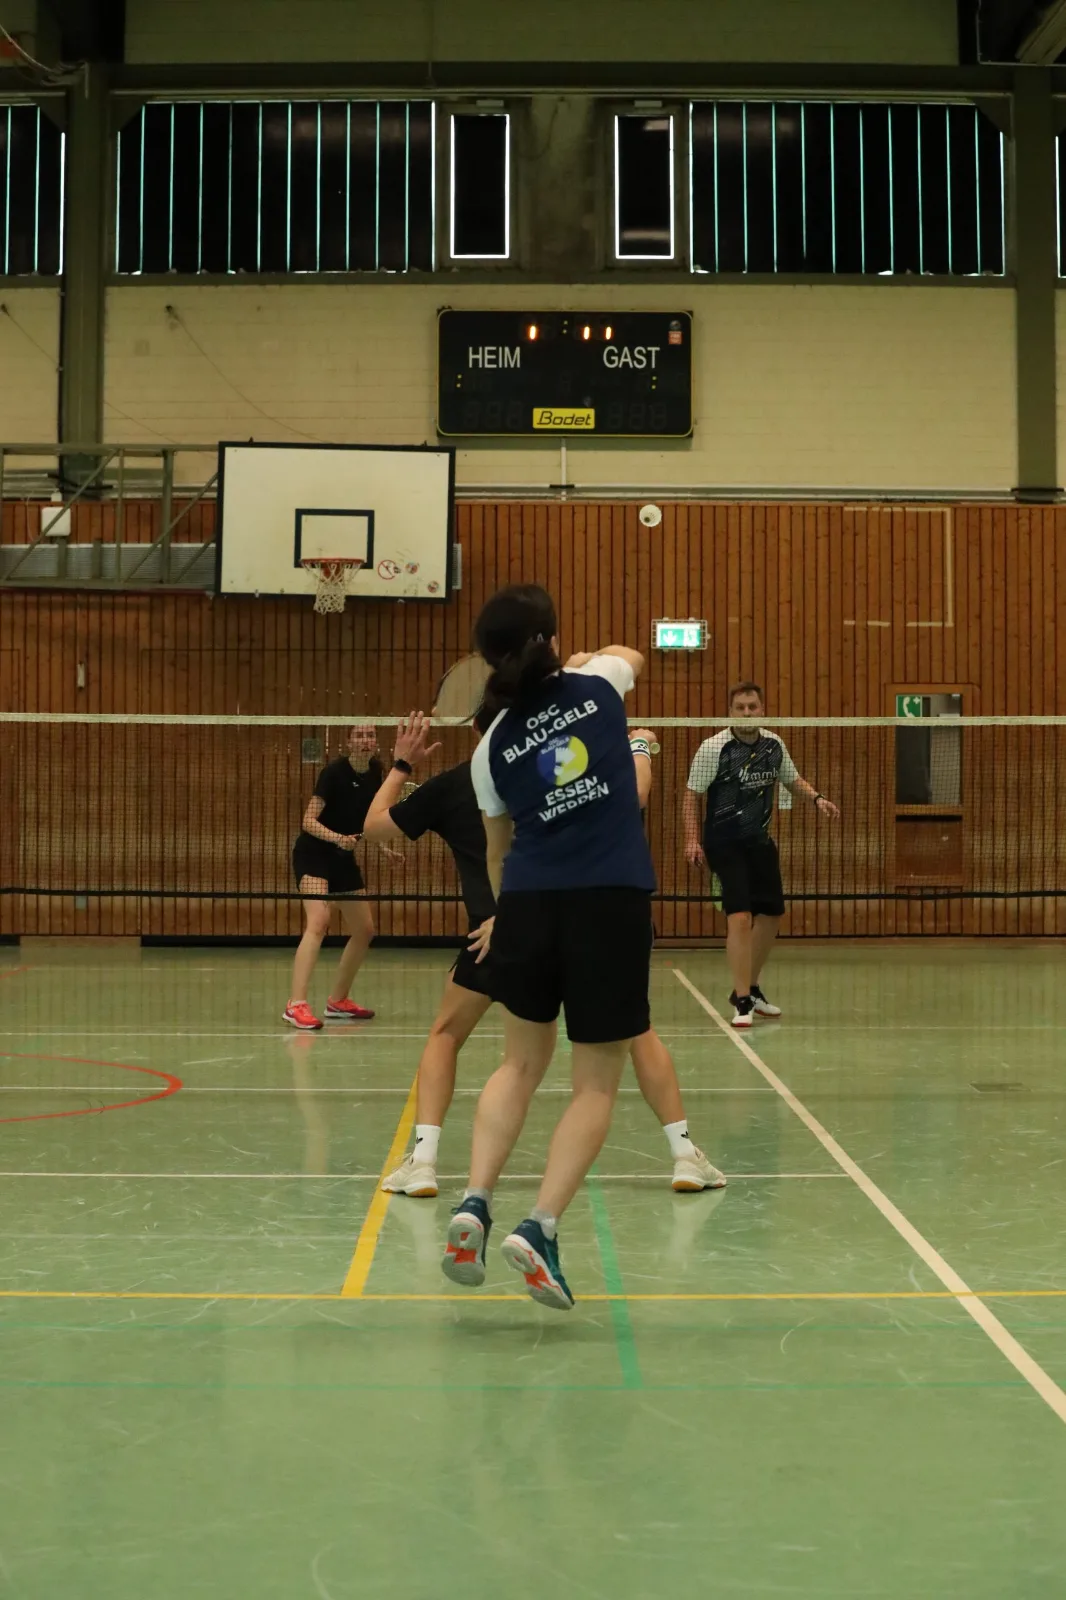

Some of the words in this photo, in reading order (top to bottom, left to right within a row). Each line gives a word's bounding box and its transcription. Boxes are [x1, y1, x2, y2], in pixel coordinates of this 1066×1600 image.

[468, 346, 521, 368] HEIM
[603, 346, 660, 369] GAST
[536, 411, 592, 426] Bodet
[526, 704, 561, 729] OSC
[502, 699, 598, 763] BLAU-GELB
[545, 776, 598, 806] ESSEN
